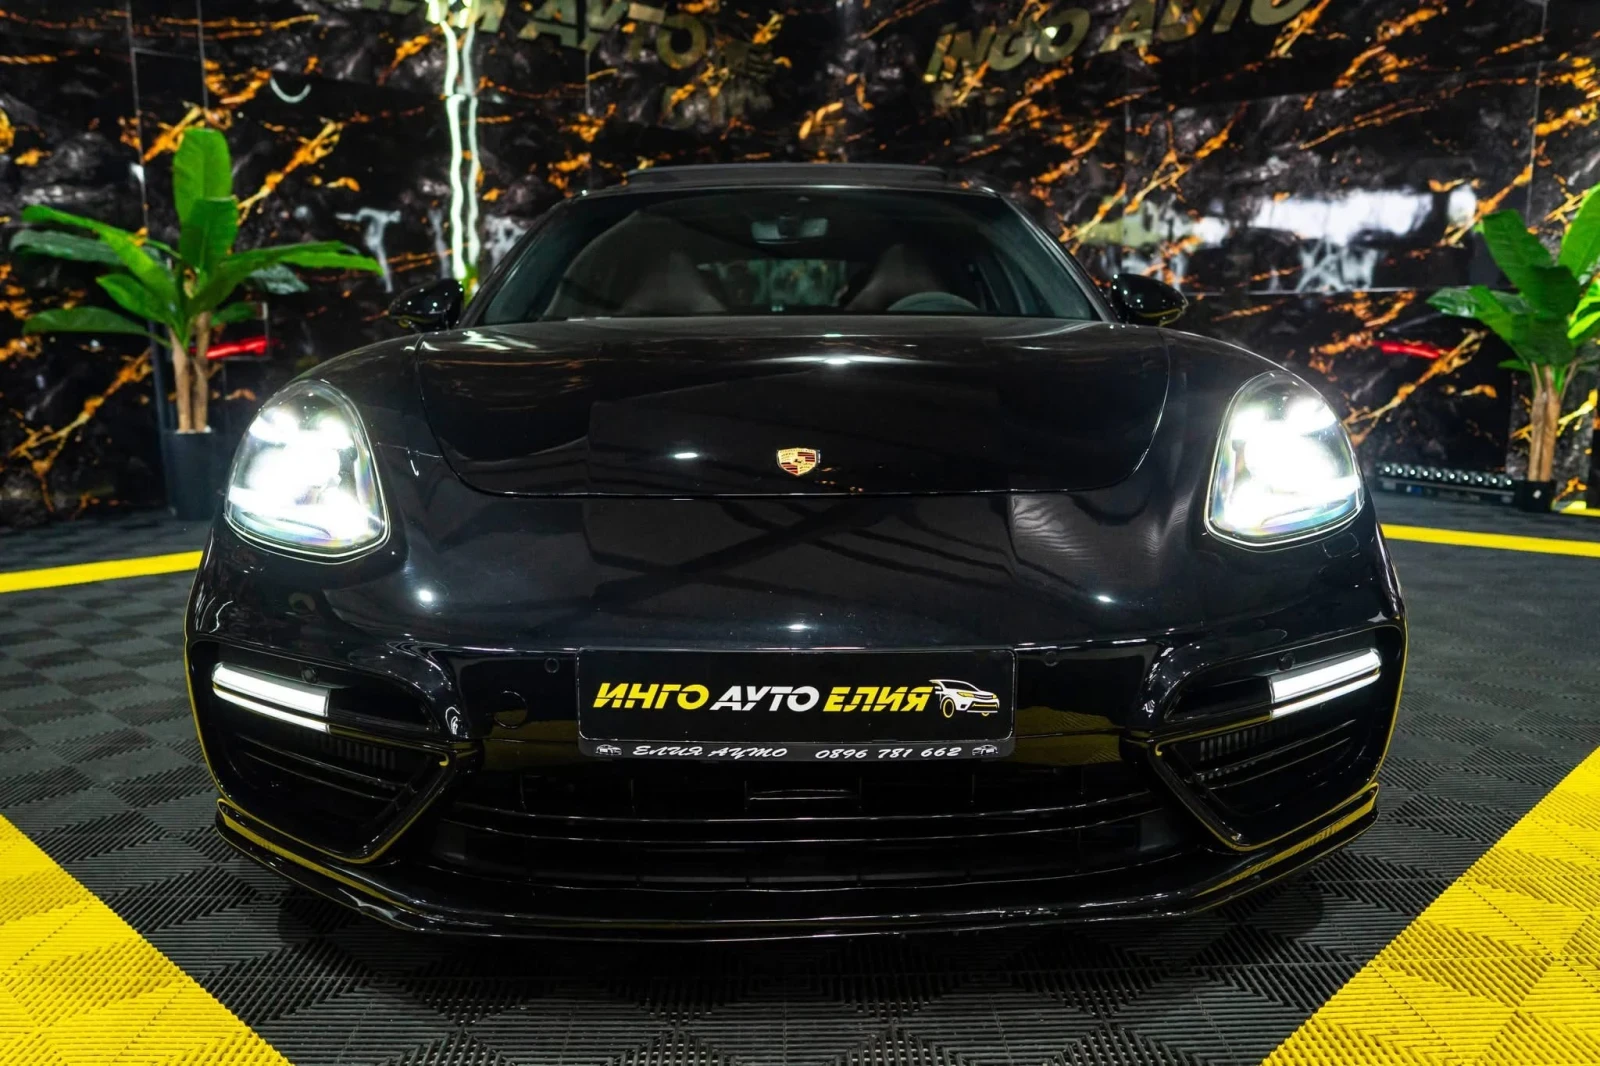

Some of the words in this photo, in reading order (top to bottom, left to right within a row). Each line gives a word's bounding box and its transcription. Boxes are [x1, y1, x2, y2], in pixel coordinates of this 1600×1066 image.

[922, 7, 1091, 83] INGO
[593, 683, 709, 710] ИНГО
[709, 686, 820, 712] АУТО
[823, 686, 934, 712] ЕЛИЯ
[814, 748, 868, 760] 0896
[877, 748, 914, 760] 781
[920, 747, 962, 758] 662
